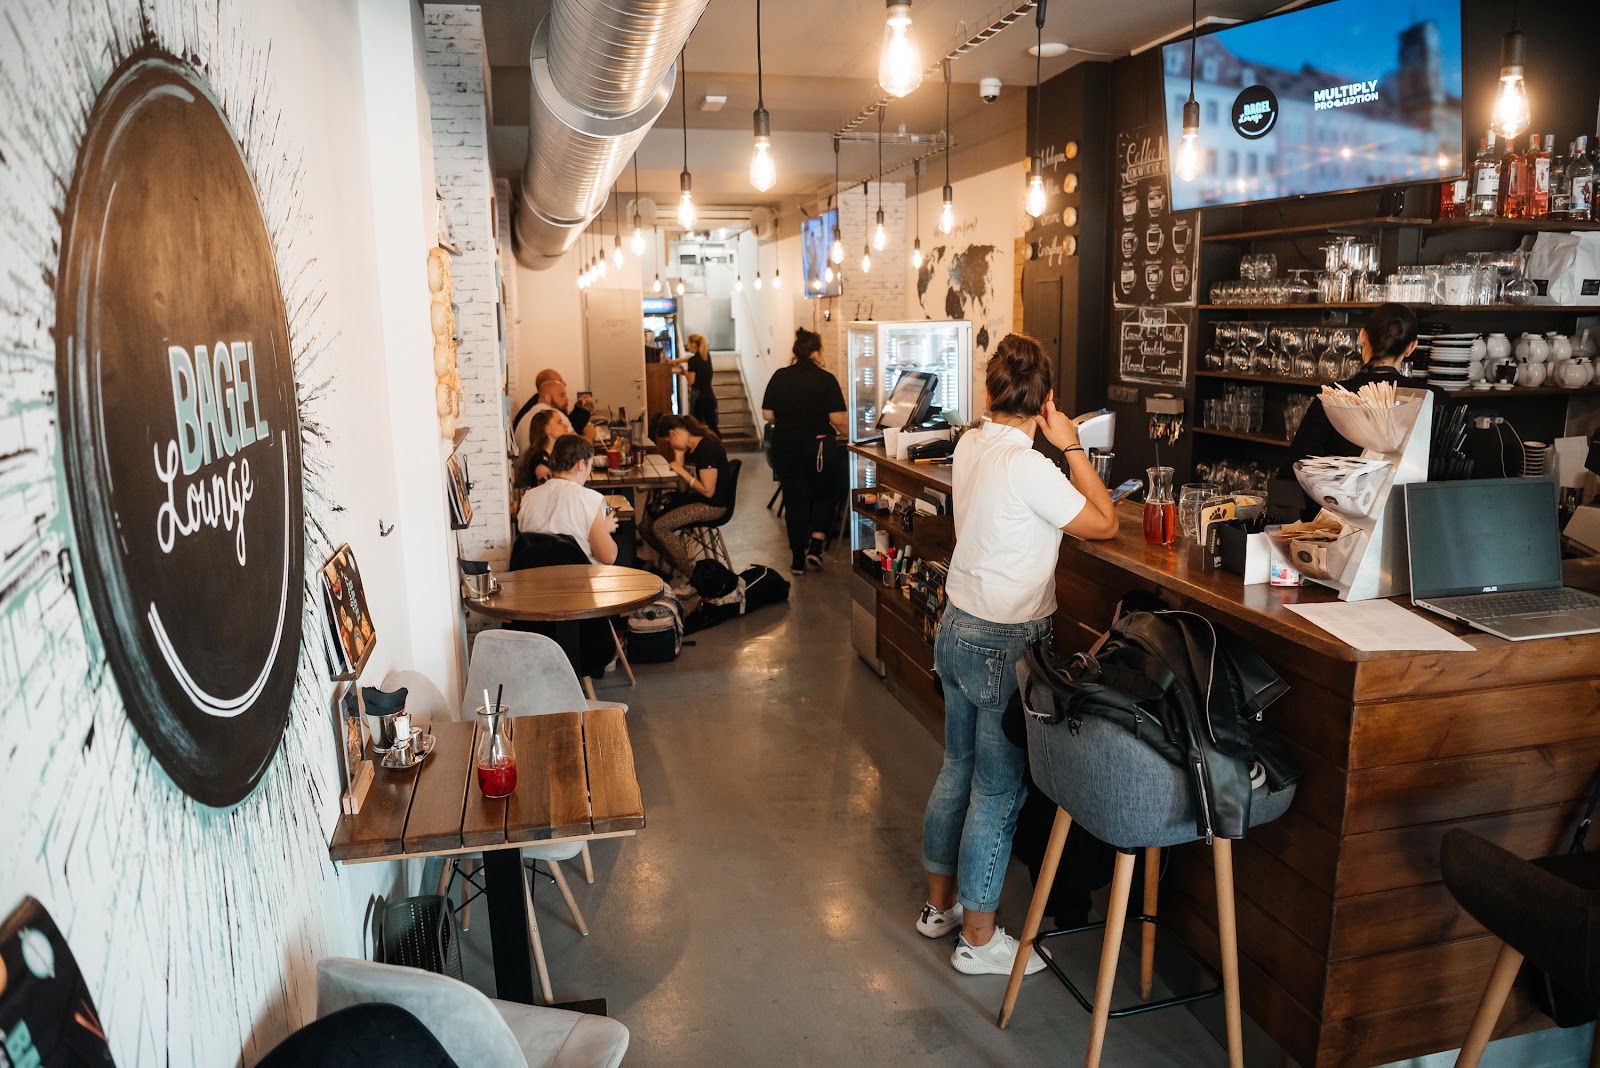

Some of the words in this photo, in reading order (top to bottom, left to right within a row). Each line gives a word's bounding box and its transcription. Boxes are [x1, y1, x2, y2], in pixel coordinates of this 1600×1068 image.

[1243, 100, 1271, 117] BAGEL
[1314, 80, 1378, 102] MULTIPLY
[168, 341, 269, 475] BAGEL
[154, 439, 254, 566] Lounge
